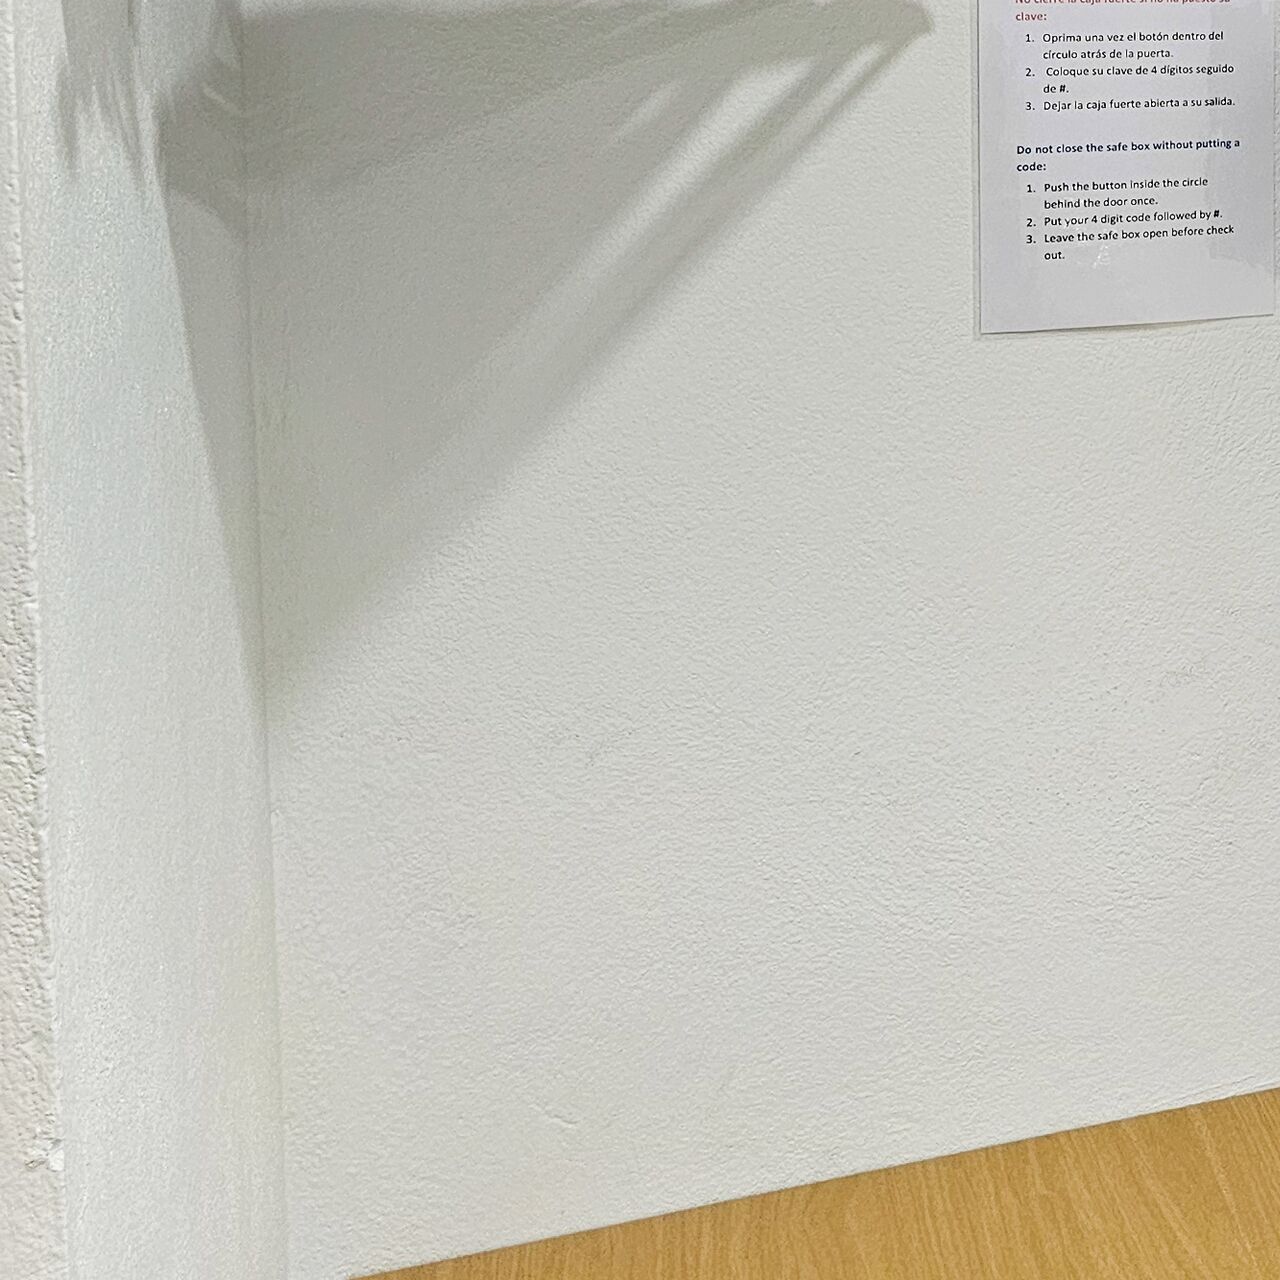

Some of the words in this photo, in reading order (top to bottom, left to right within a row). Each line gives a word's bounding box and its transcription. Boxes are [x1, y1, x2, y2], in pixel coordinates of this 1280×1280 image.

[1016, 12, 1047, 21] clave:
[1026, 34, 1034, 42] 1.
[1043, 33, 1081, 44] Oprima
[1127, 32, 1136, 41] el
[1139, 32, 1168, 41] botón
[1172, 32, 1206, 40] dentro
[1209, 31, 1223, 40] del
[1043, 50, 1077, 59] círculo
[1081, 49, 1106, 58] atrás
[1110, 49, 1122, 58] de
[1126, 49, 1133, 58] la
[1137, 50, 1174, 59] puerta.
[1026, 68, 1035, 76] 2.
[1046, 67, 1089, 77] Coloque
[1107, 66, 1132, 75] clave
[1136, 66, 1148, 75] de
[1151, 66, 1157, 74] 4
[1160, 65, 1193, 76] dígitos
[1196, 64, 1234, 75] seguido
[1044, 84, 1056, 93] de
[1026, 102, 1035, 110] 3.
[1044, 101, 1071, 112] Dejar
[1075, 101, 1083, 109] la
[1087, 100, 1106, 111] caja
[1110, 99, 1141, 108] fuerte
[1144, 99, 1179, 107] abierta
[1205, 97, 1236, 106] salida.
[1017, 146, 1031, 154] Do
[1036, 145, 1053, 153] not
[1057, 144, 1083, 153] close
[1086, 143, 1103, 152] the
[1107, 142, 1127, 151] safe
[1132, 142, 1150, 150] box
[1153, 141, 1193, 149] without
[1196, 139, 1231, 150] putting
[1017, 162, 1047, 171] code:
[1045, 183, 1069, 192] Push
[1072, 182, 1089, 191] the
[1093, 182, 1127, 190] button
[1131, 179, 1160, 189] inside
[1163, 179, 1179, 187] the
[1182, 177, 1208, 187] circle
[1044, 199, 1080, 209] behind
[1084, 199, 1100, 207] the
[1104, 197, 1128, 206] door
[1027, 218, 1036, 227] 2.
[1045, 217, 1062, 226] Put
[1065, 217, 1089, 227] your
[1091, 215, 1097, 223] 4
[1101, 215, 1123, 225] digit
[1126, 213, 1150, 222] code
[1154, 211, 1196, 221] followed
[1200, 210, 1211, 220] by
[1026, 235, 1036, 243] 3.
[1045, 234, 1074, 242] Leave
[1077, 232, 1094, 241] the
[1098, 231, 1118, 240] safe
[1122, 230, 1140, 239] box
[1143, 231, 1168, 239] open
[1172, 227, 1204, 236] before
[1207, 225, 1234, 235] check
[1044, 252, 1065, 260] out.
